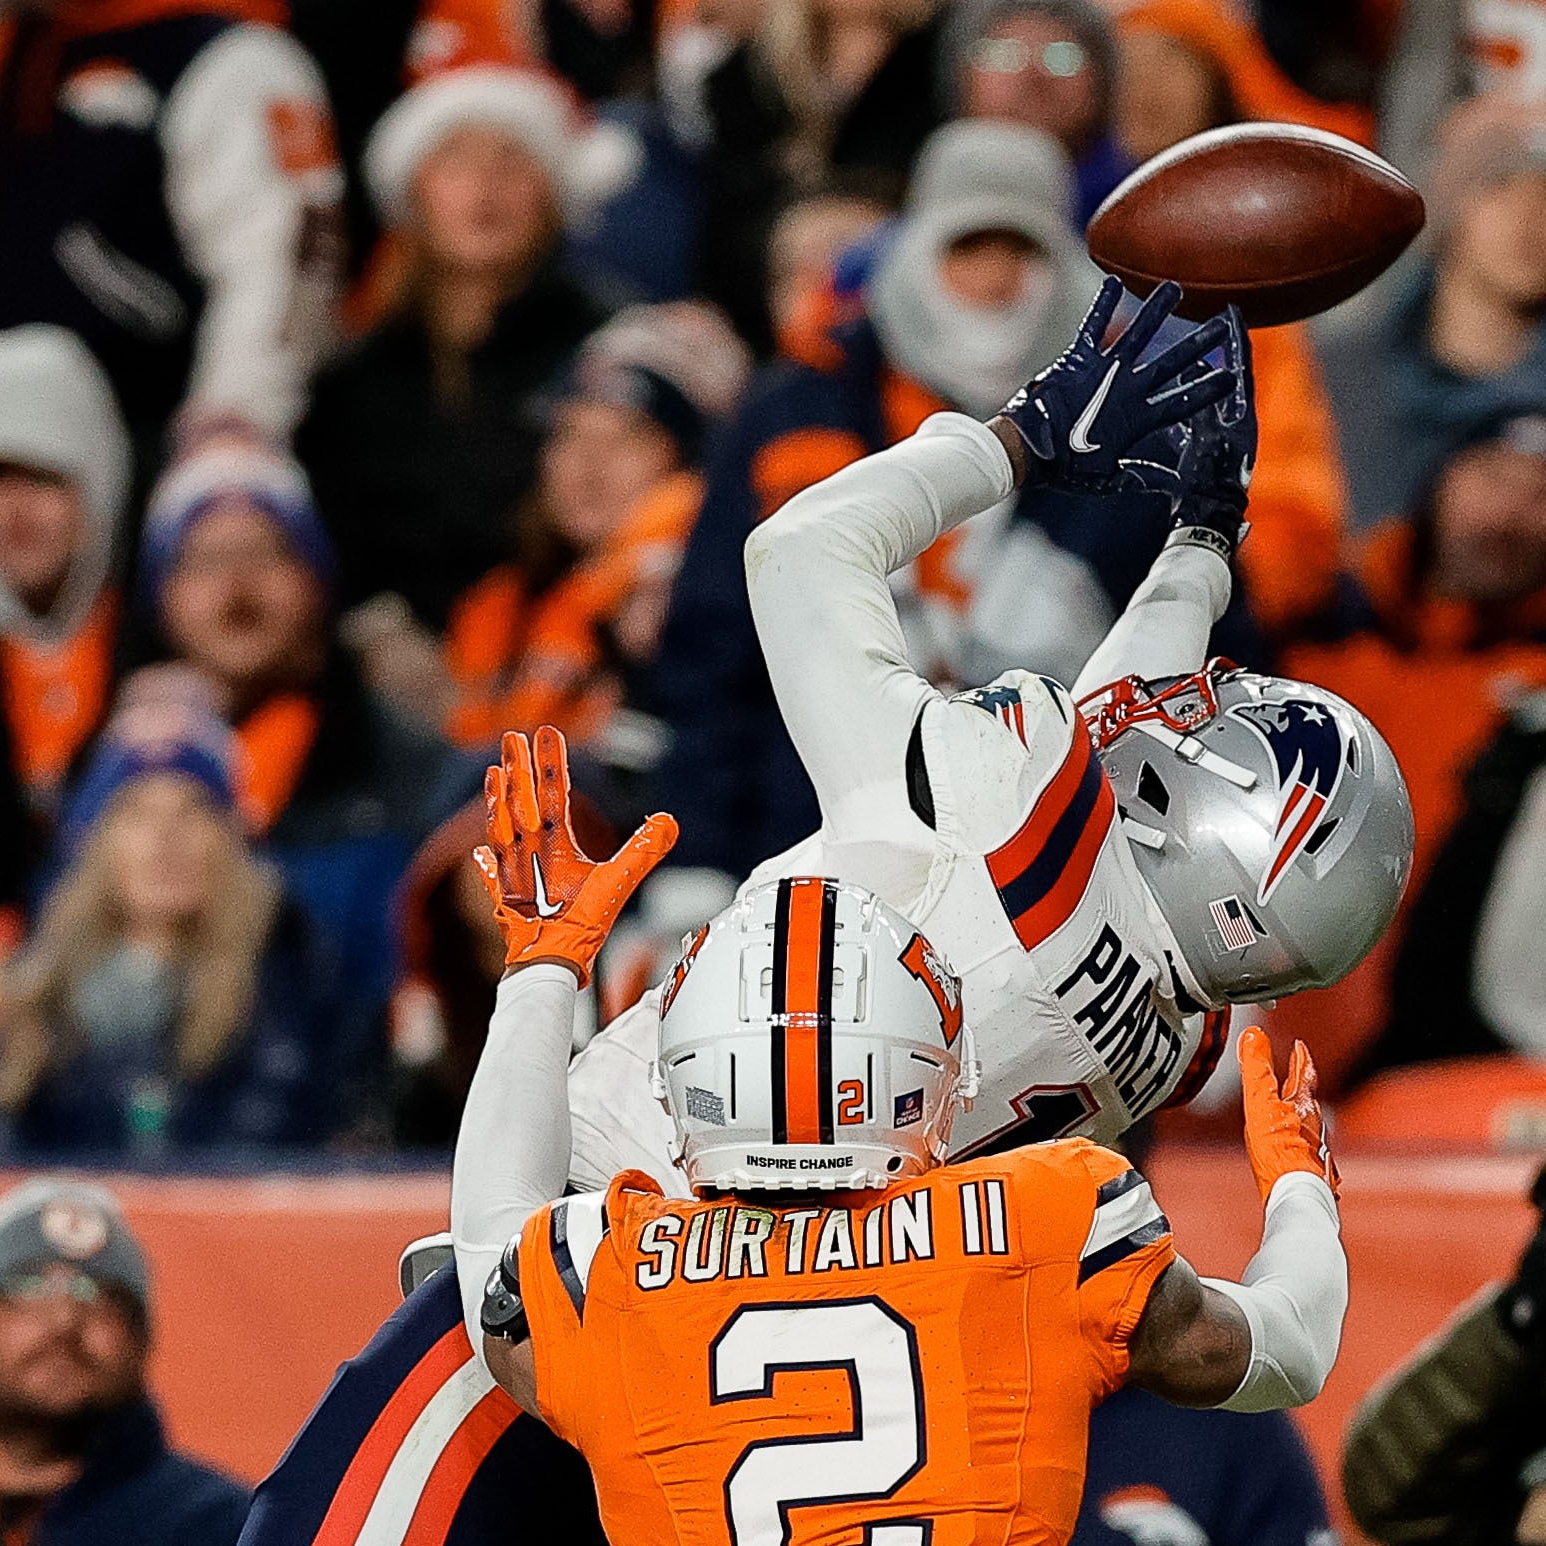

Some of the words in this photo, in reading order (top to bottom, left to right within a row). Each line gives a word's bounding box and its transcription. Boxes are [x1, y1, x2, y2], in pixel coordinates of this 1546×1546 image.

[1055, 921, 1182, 1119] PARKER
[837, 1079, 865, 1126] 2
[746, 1154, 797, 1170] INSPIRE
[799, 1155, 854, 1170] CHANGE
[635, 1190, 935, 1291] SURTAIN
[958, 1179, 1010, 1255] II
